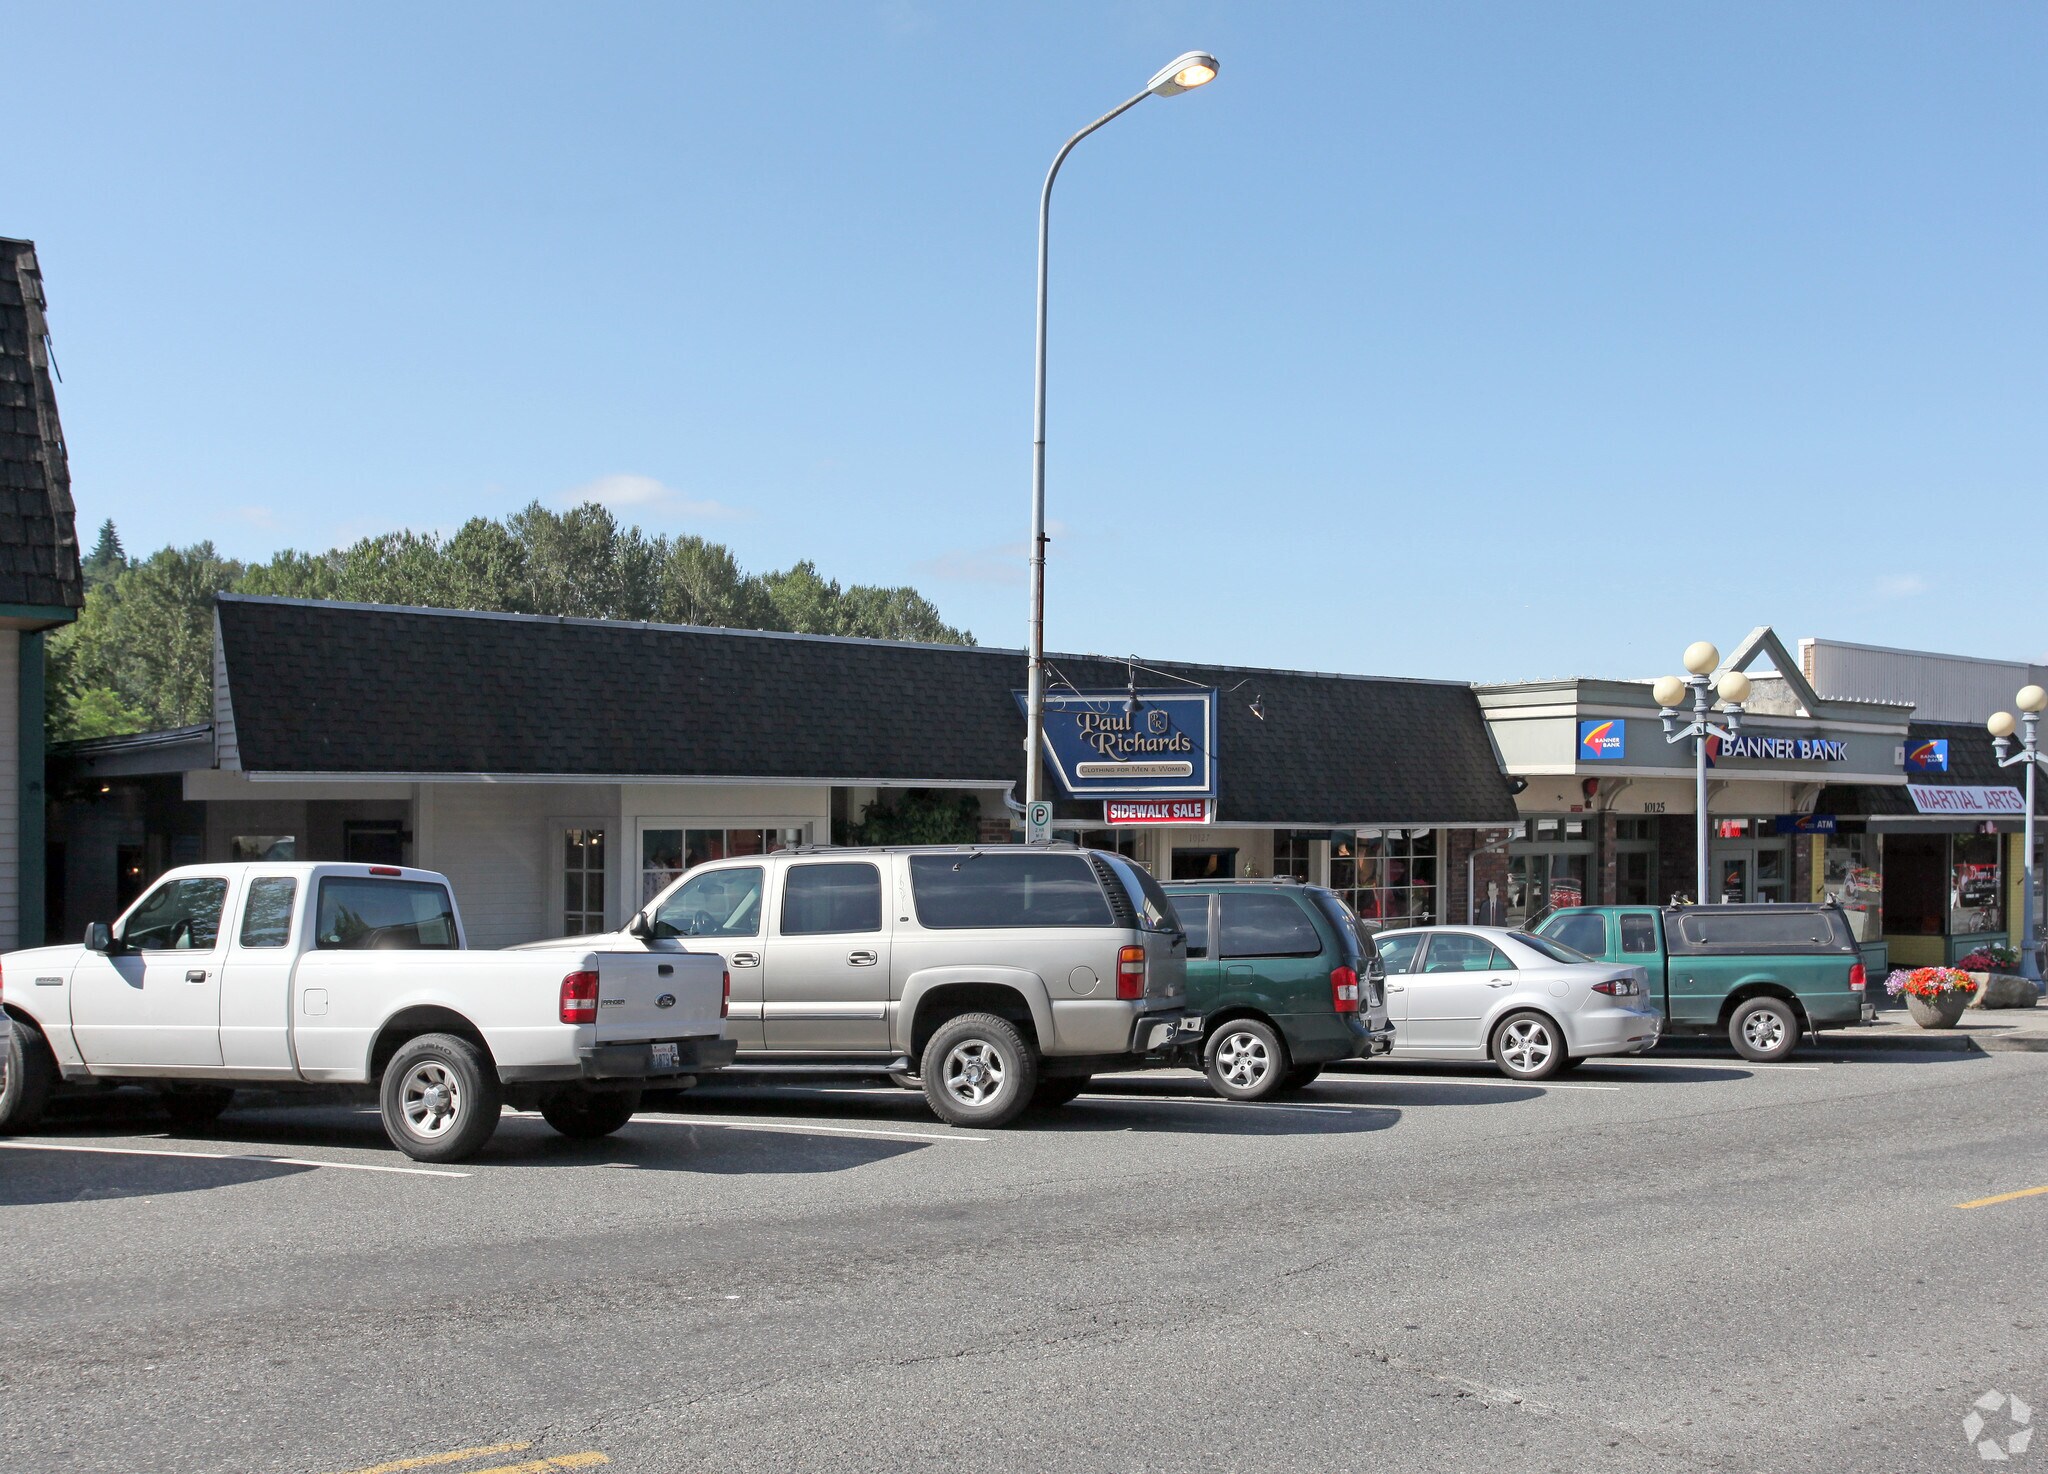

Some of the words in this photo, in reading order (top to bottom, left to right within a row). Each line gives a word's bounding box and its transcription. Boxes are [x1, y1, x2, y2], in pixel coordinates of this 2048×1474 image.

[1077, 711, 1131, 739] Paul
[1091, 732, 1191, 761] Richards
[1722, 736, 1795, 759] BANNER
[1801, 740, 1848, 760] BANK
[1644, 802, 1665, 813] 10125
[1913, 789, 1983, 809] MARTIAL
[1983, 790, 2023, 810] ARTS
[1036, 808, 1045, 822] P
[1110, 804, 1169, 819] SIDEWALK
[1173, 803, 1201, 818] SALE
[1816, 820, 1834, 829] ATM
